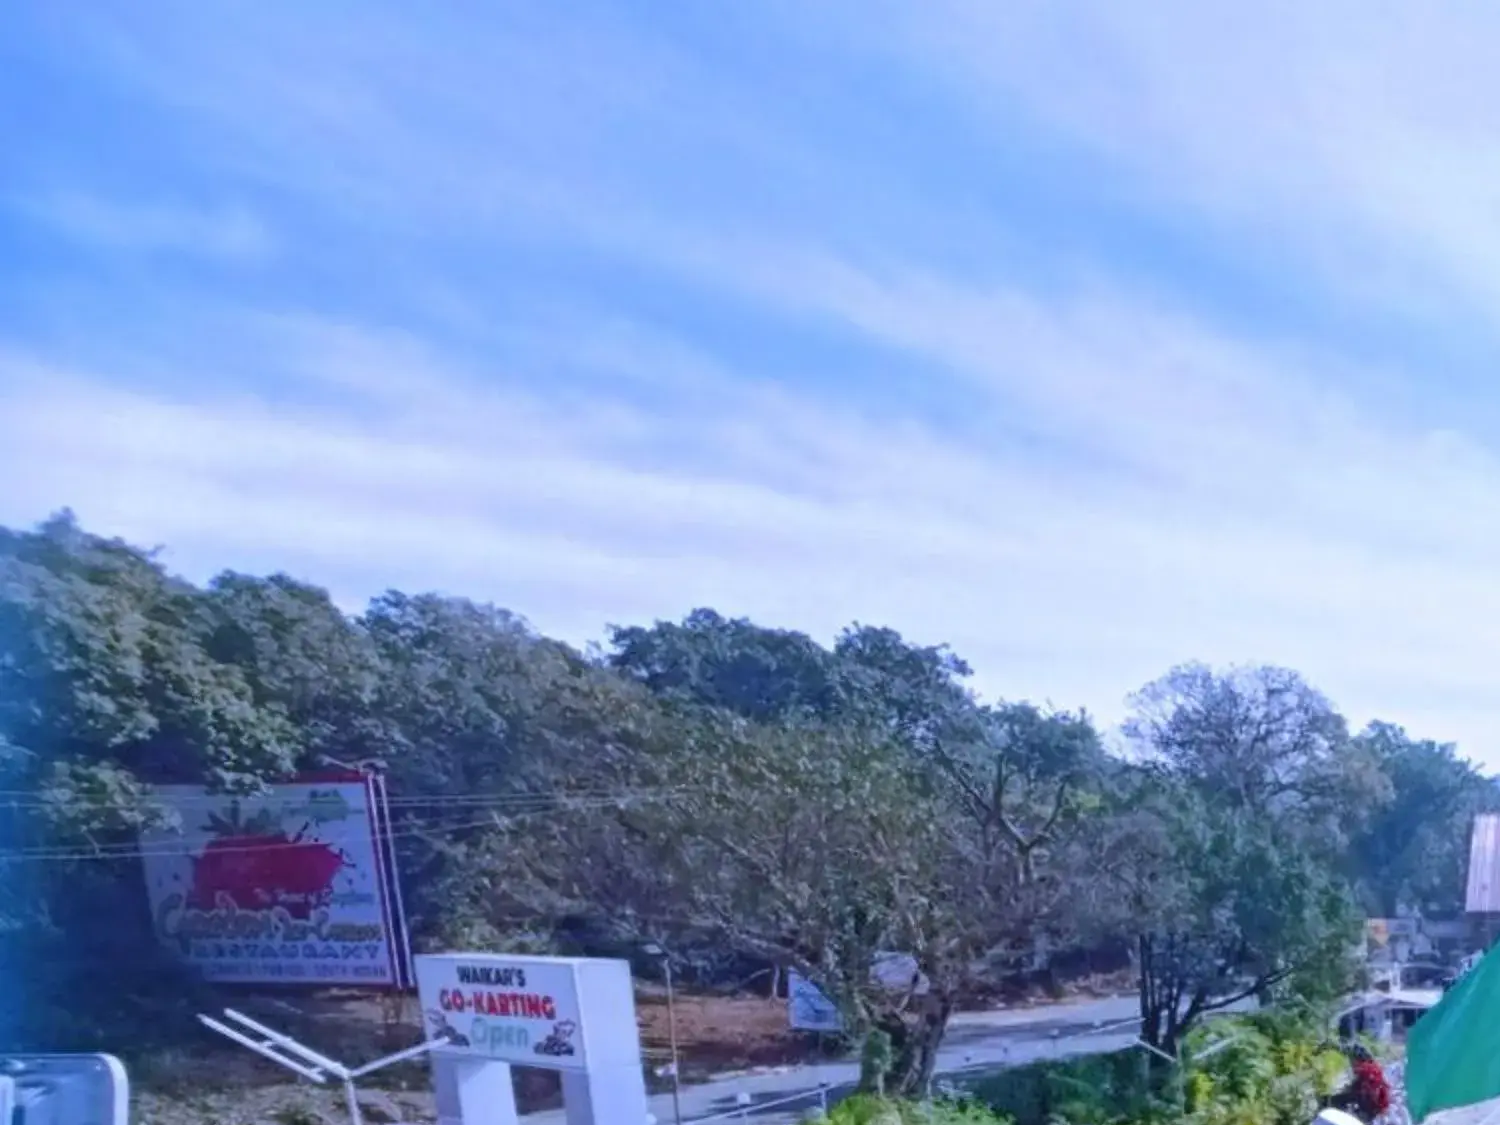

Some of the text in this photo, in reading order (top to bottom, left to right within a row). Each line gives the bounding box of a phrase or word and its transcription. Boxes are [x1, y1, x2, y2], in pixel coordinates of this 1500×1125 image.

[456, 965, 526, 988] WAIKAR'S
[439, 988, 557, 1021] GO-KARTING
[471, 1016, 529, 1055] Open
